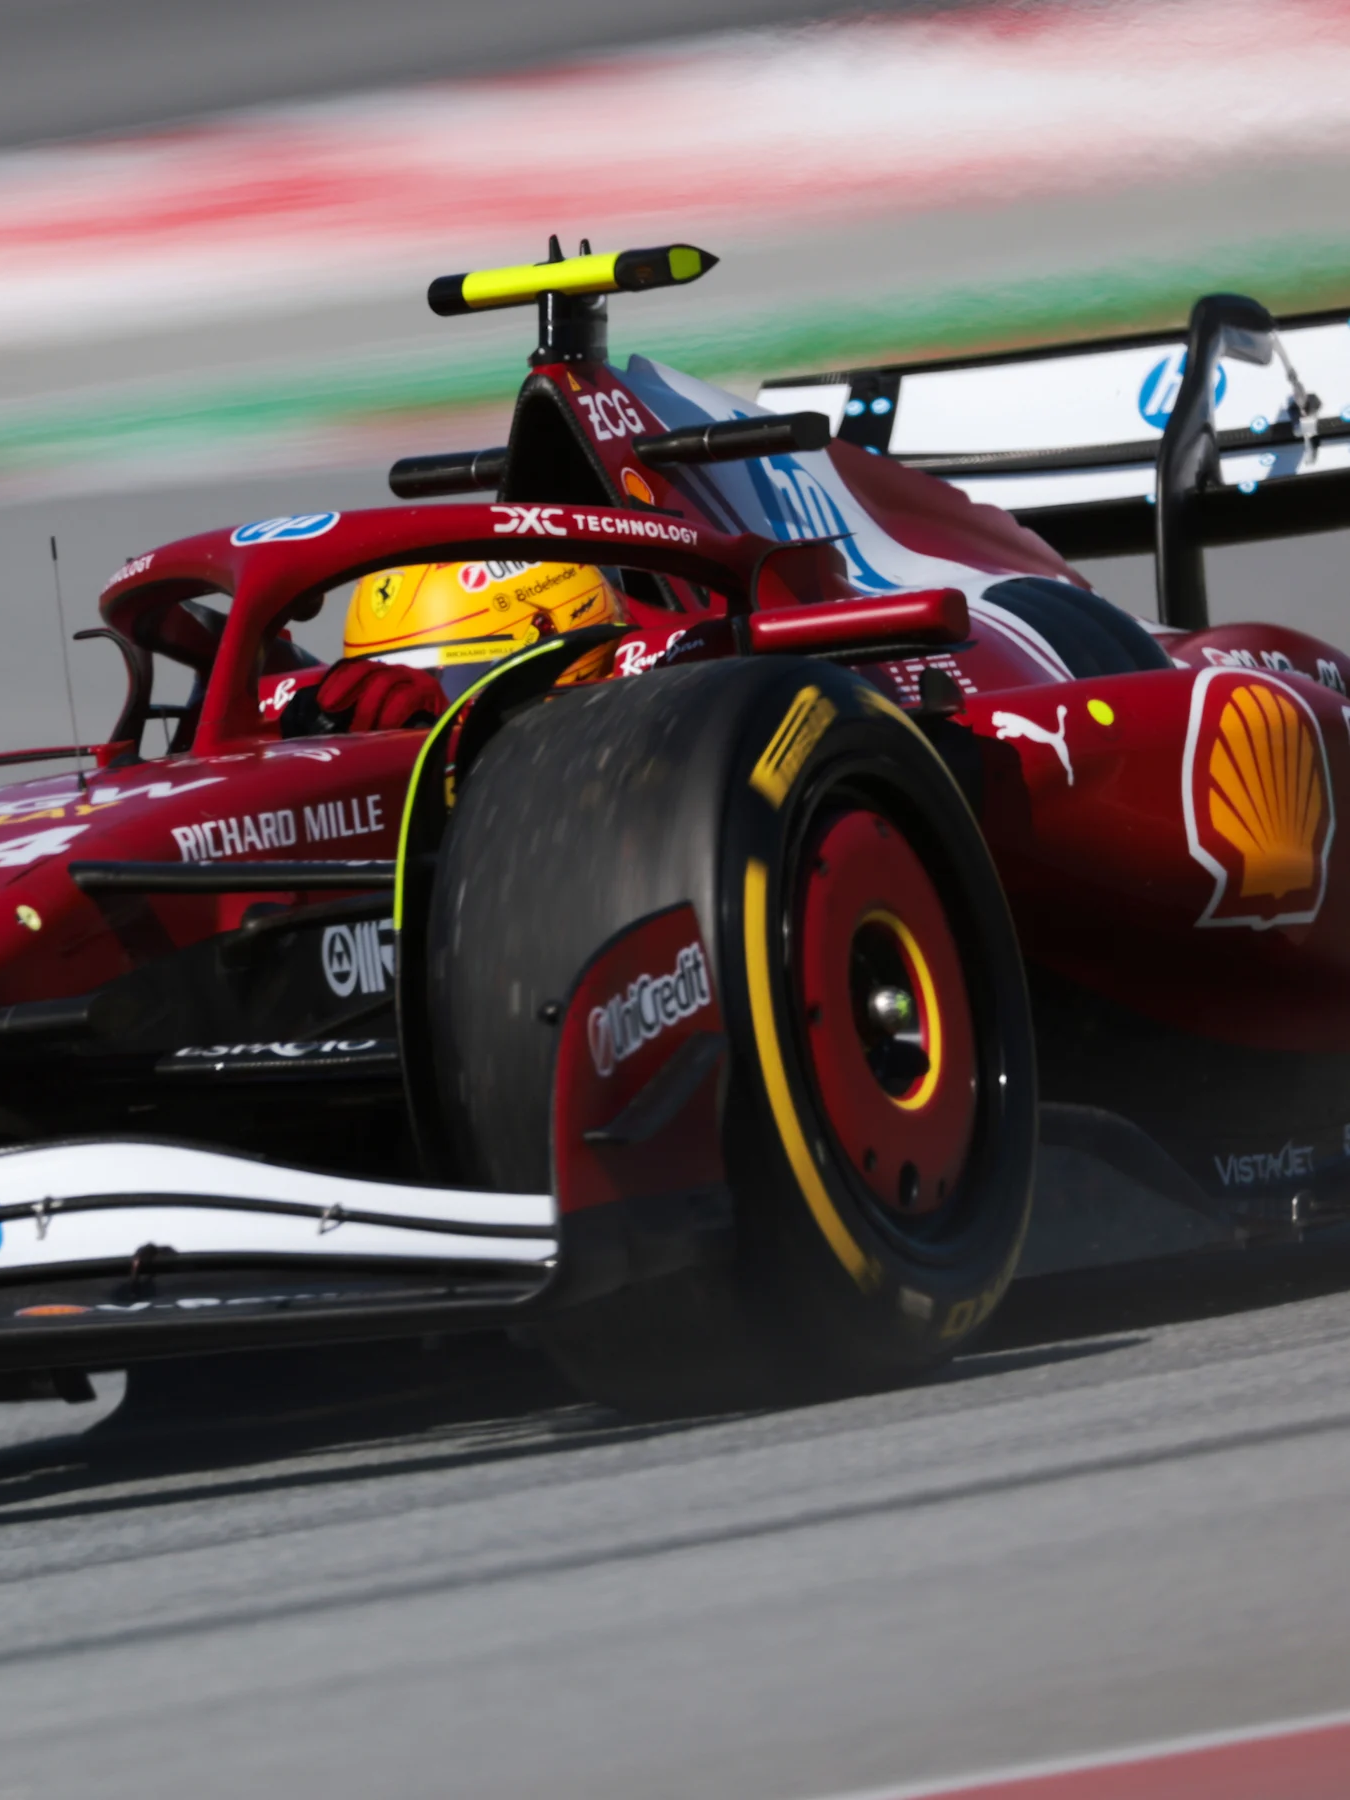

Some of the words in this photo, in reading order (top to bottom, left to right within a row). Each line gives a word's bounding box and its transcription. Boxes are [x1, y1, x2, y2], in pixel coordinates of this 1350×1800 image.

[578, 389, 645, 441] ZCG
[233, 512, 338, 544] hp
[490, 506, 567, 536] DXC
[572, 514, 698, 545] TECHNOLOGY
[513, 565, 578, 602] Bitdefender
[171, 809, 297, 863] RICHARD
[303, 794, 385, 843] MILLE
